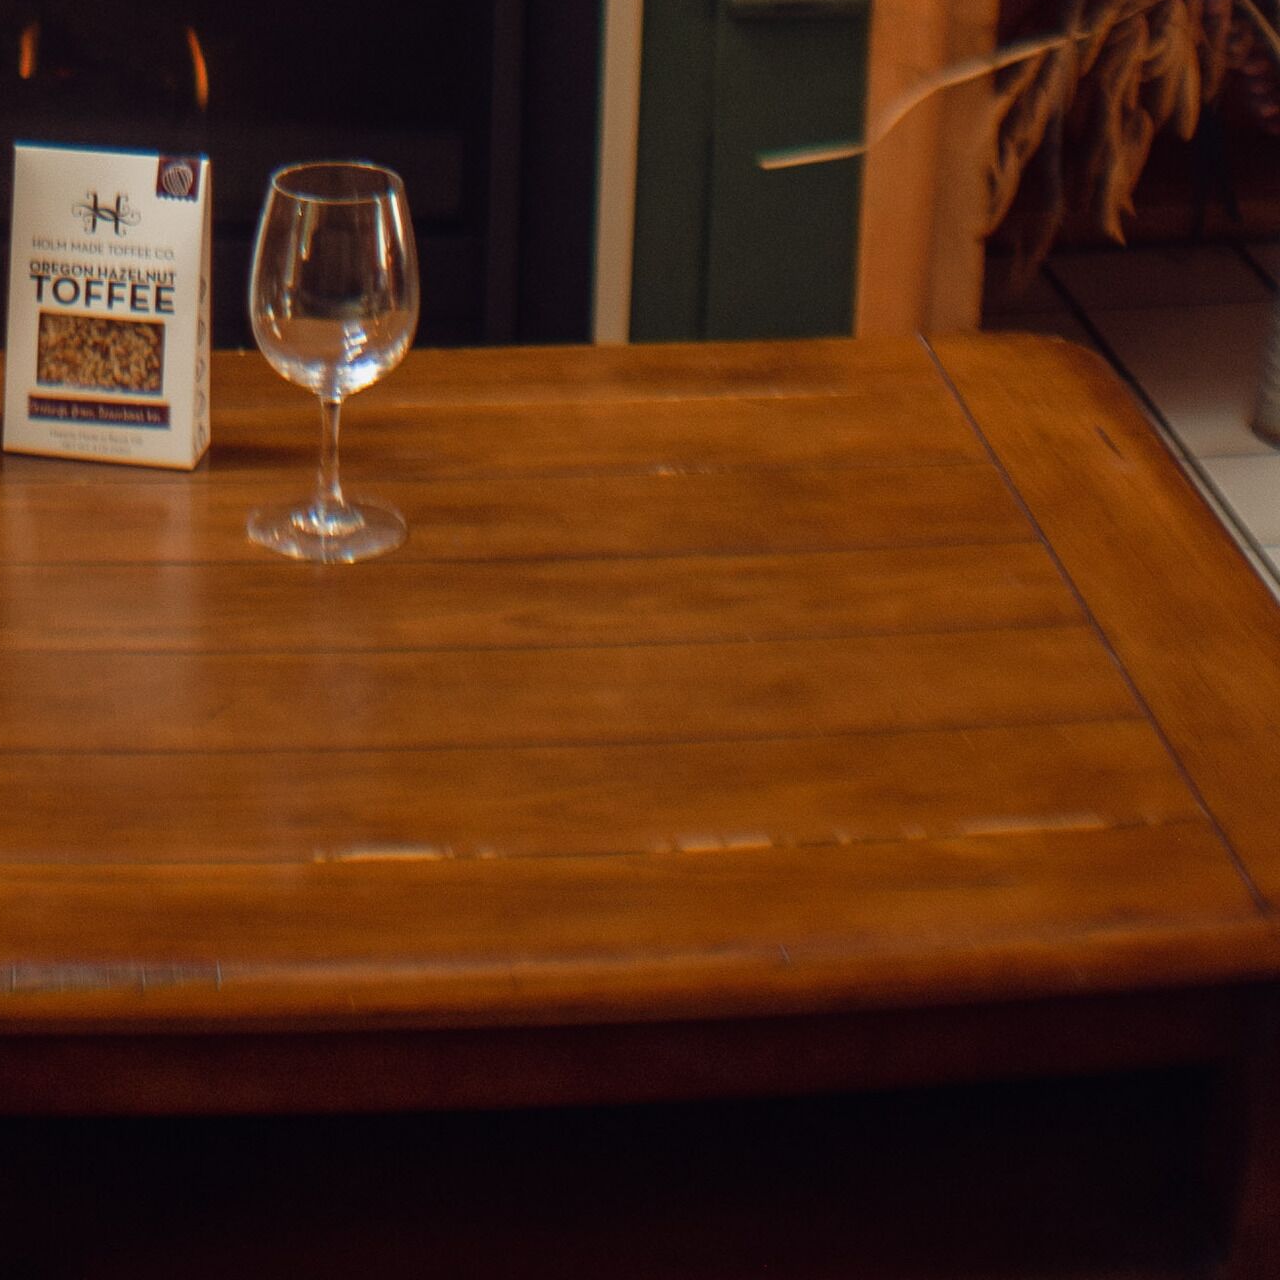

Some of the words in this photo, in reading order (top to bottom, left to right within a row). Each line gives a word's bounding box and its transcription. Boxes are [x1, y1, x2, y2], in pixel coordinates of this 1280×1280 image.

[32, 239, 67, 251] HOLM
[71, 242, 104, 255] MADE
[108, 245, 152, 259] TOFFEE
[30, 261, 94, 276] OREGON
[98, 265, 177, 285] HAZELNUT
[30, 274, 176, 315] TOFFEE
